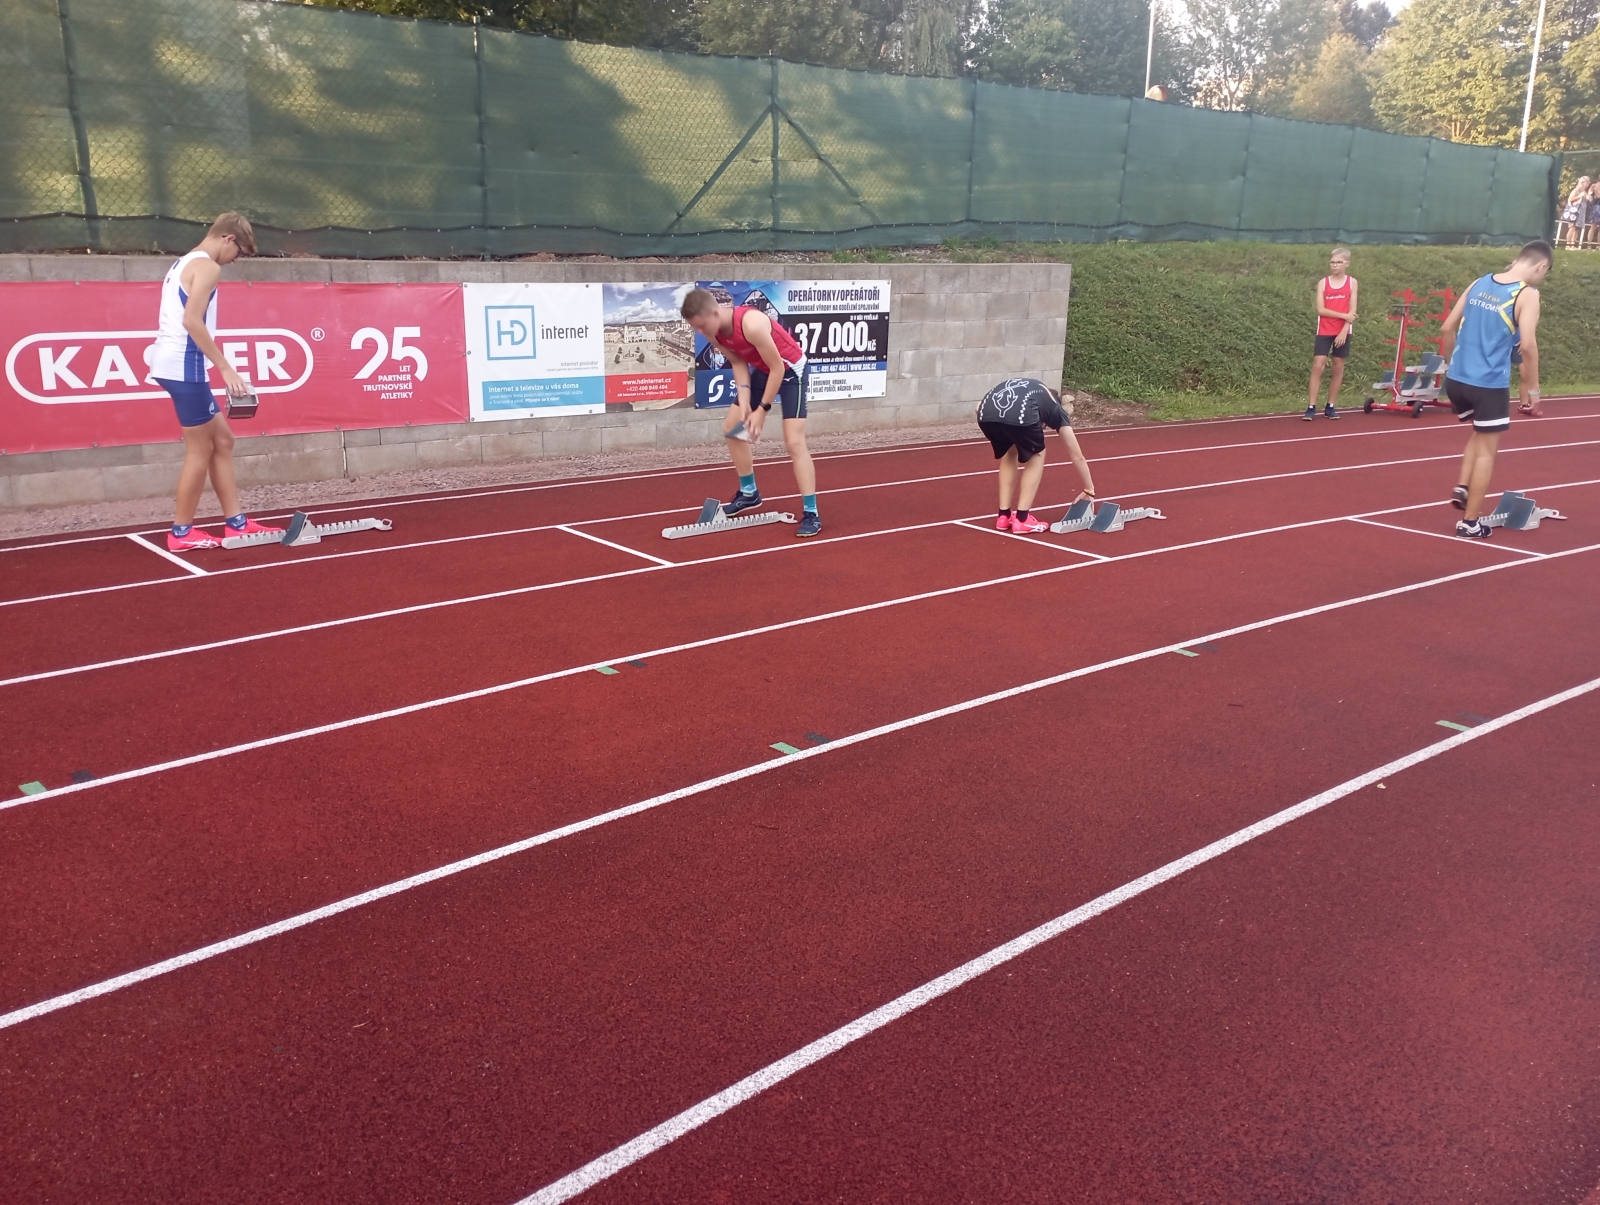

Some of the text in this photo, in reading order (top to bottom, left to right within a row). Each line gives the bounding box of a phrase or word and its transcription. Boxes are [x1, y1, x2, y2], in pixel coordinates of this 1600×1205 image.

[788, 286, 880, 302] OPERÁTORKY/OPERÁTOŘI
[497, 320, 527, 346] HD
[541, 324, 589, 340] internet
[350, 326, 428, 382] 25
[38, 341, 292, 391] KAER
[363, 381, 413, 391] TRUTNOVSKÉ
[378, 374, 412, 382] PARTNER
[622, 377, 672, 385] www.hdinternet.cz
